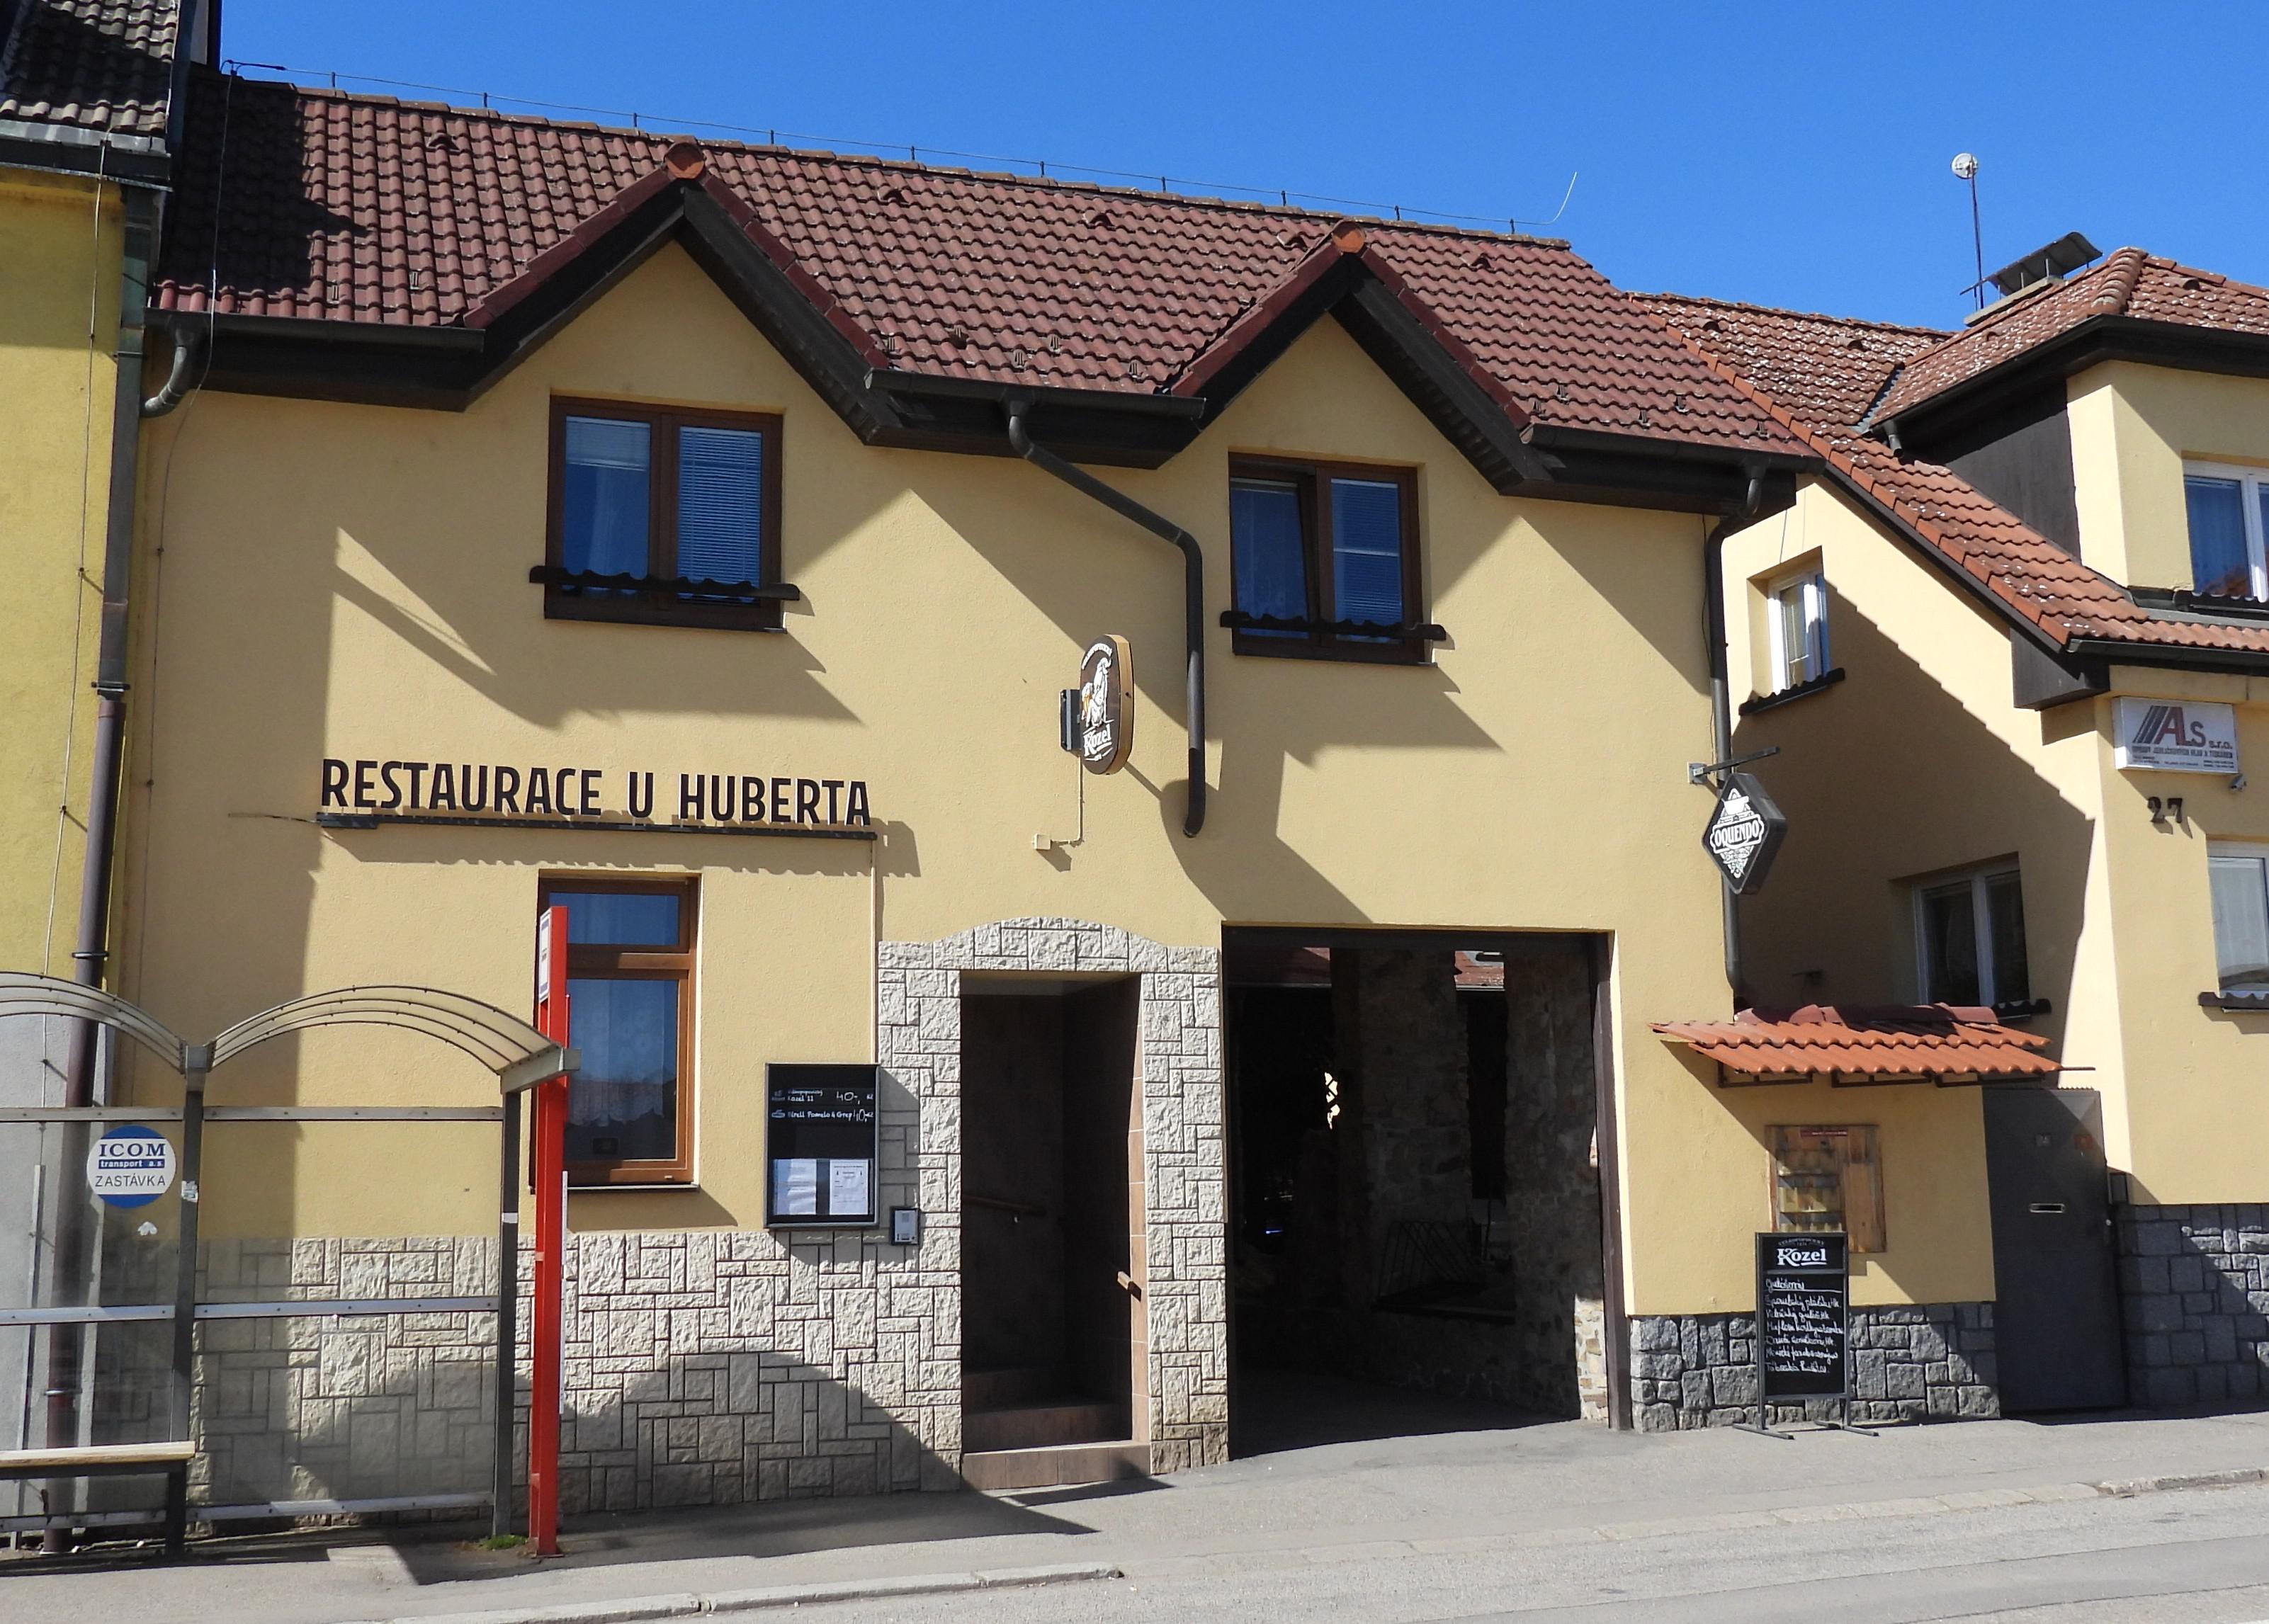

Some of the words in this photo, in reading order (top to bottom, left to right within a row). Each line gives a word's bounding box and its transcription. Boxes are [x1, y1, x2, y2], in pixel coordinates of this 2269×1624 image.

[1083, 723, 1112, 757] Kozel
[2209, 740, 2233, 750] s.r.o.
[321, 758, 604, 816] RESTAURACE
[628, 771, 655, 819] U
[678, 773, 872, 826] HUBERTA
[2147, 796, 2183, 824] 27
[1714, 819, 1760, 848] OQUENDO
[98, 1143, 166, 1157] ICOM
[101, 1159, 143, 1168] transport
[94, 1173, 166, 1187] ZASTÁVKA
[1776, 1248, 1828, 1267] Kozel
